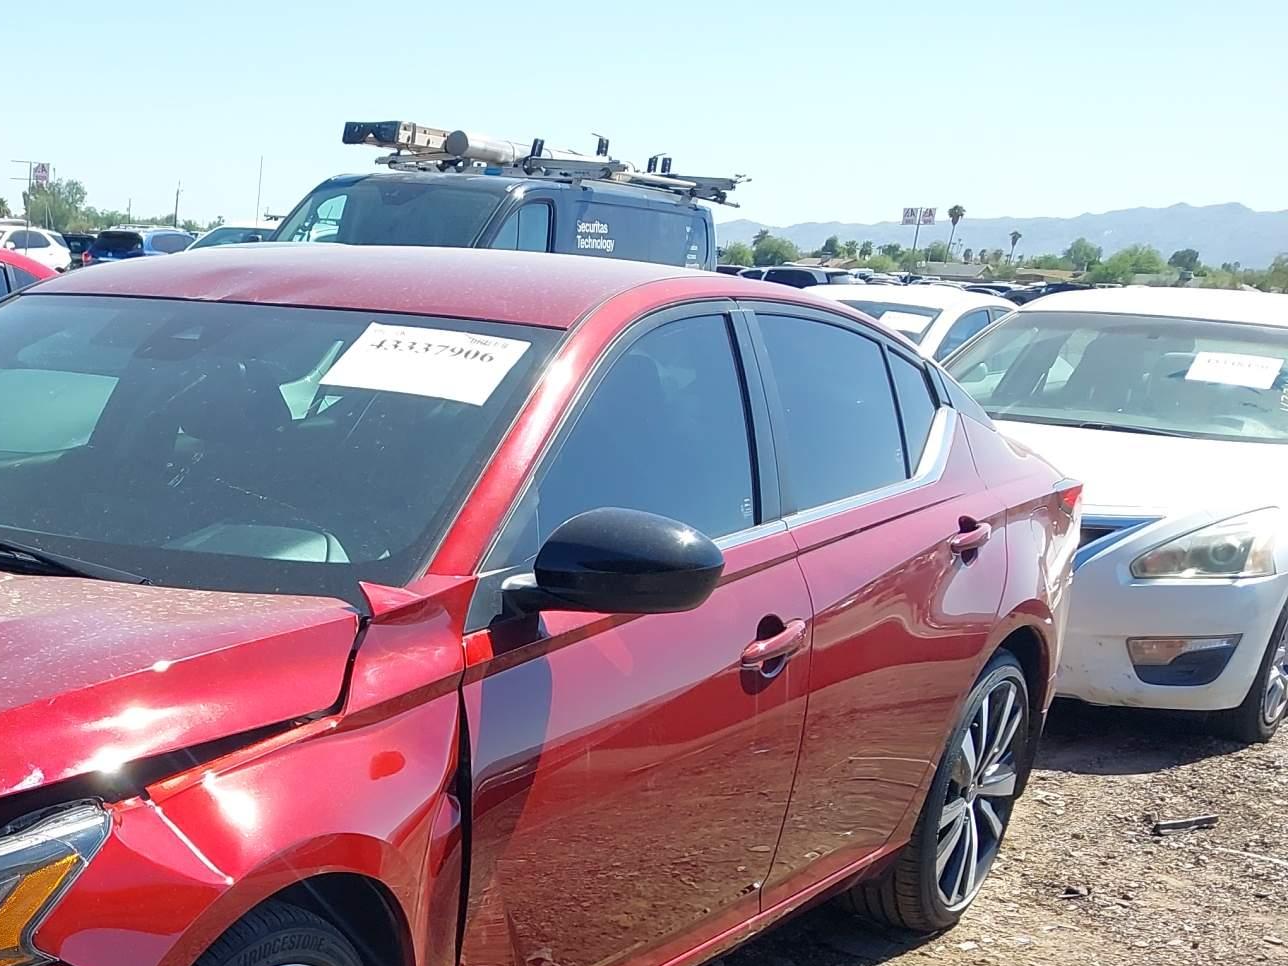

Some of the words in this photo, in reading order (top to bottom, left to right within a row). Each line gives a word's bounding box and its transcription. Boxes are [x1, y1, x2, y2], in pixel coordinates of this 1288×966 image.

[576, 219, 608, 233] Securitas
[576, 235, 614, 252] Technology
[369, 339, 494, 362] 43337906
